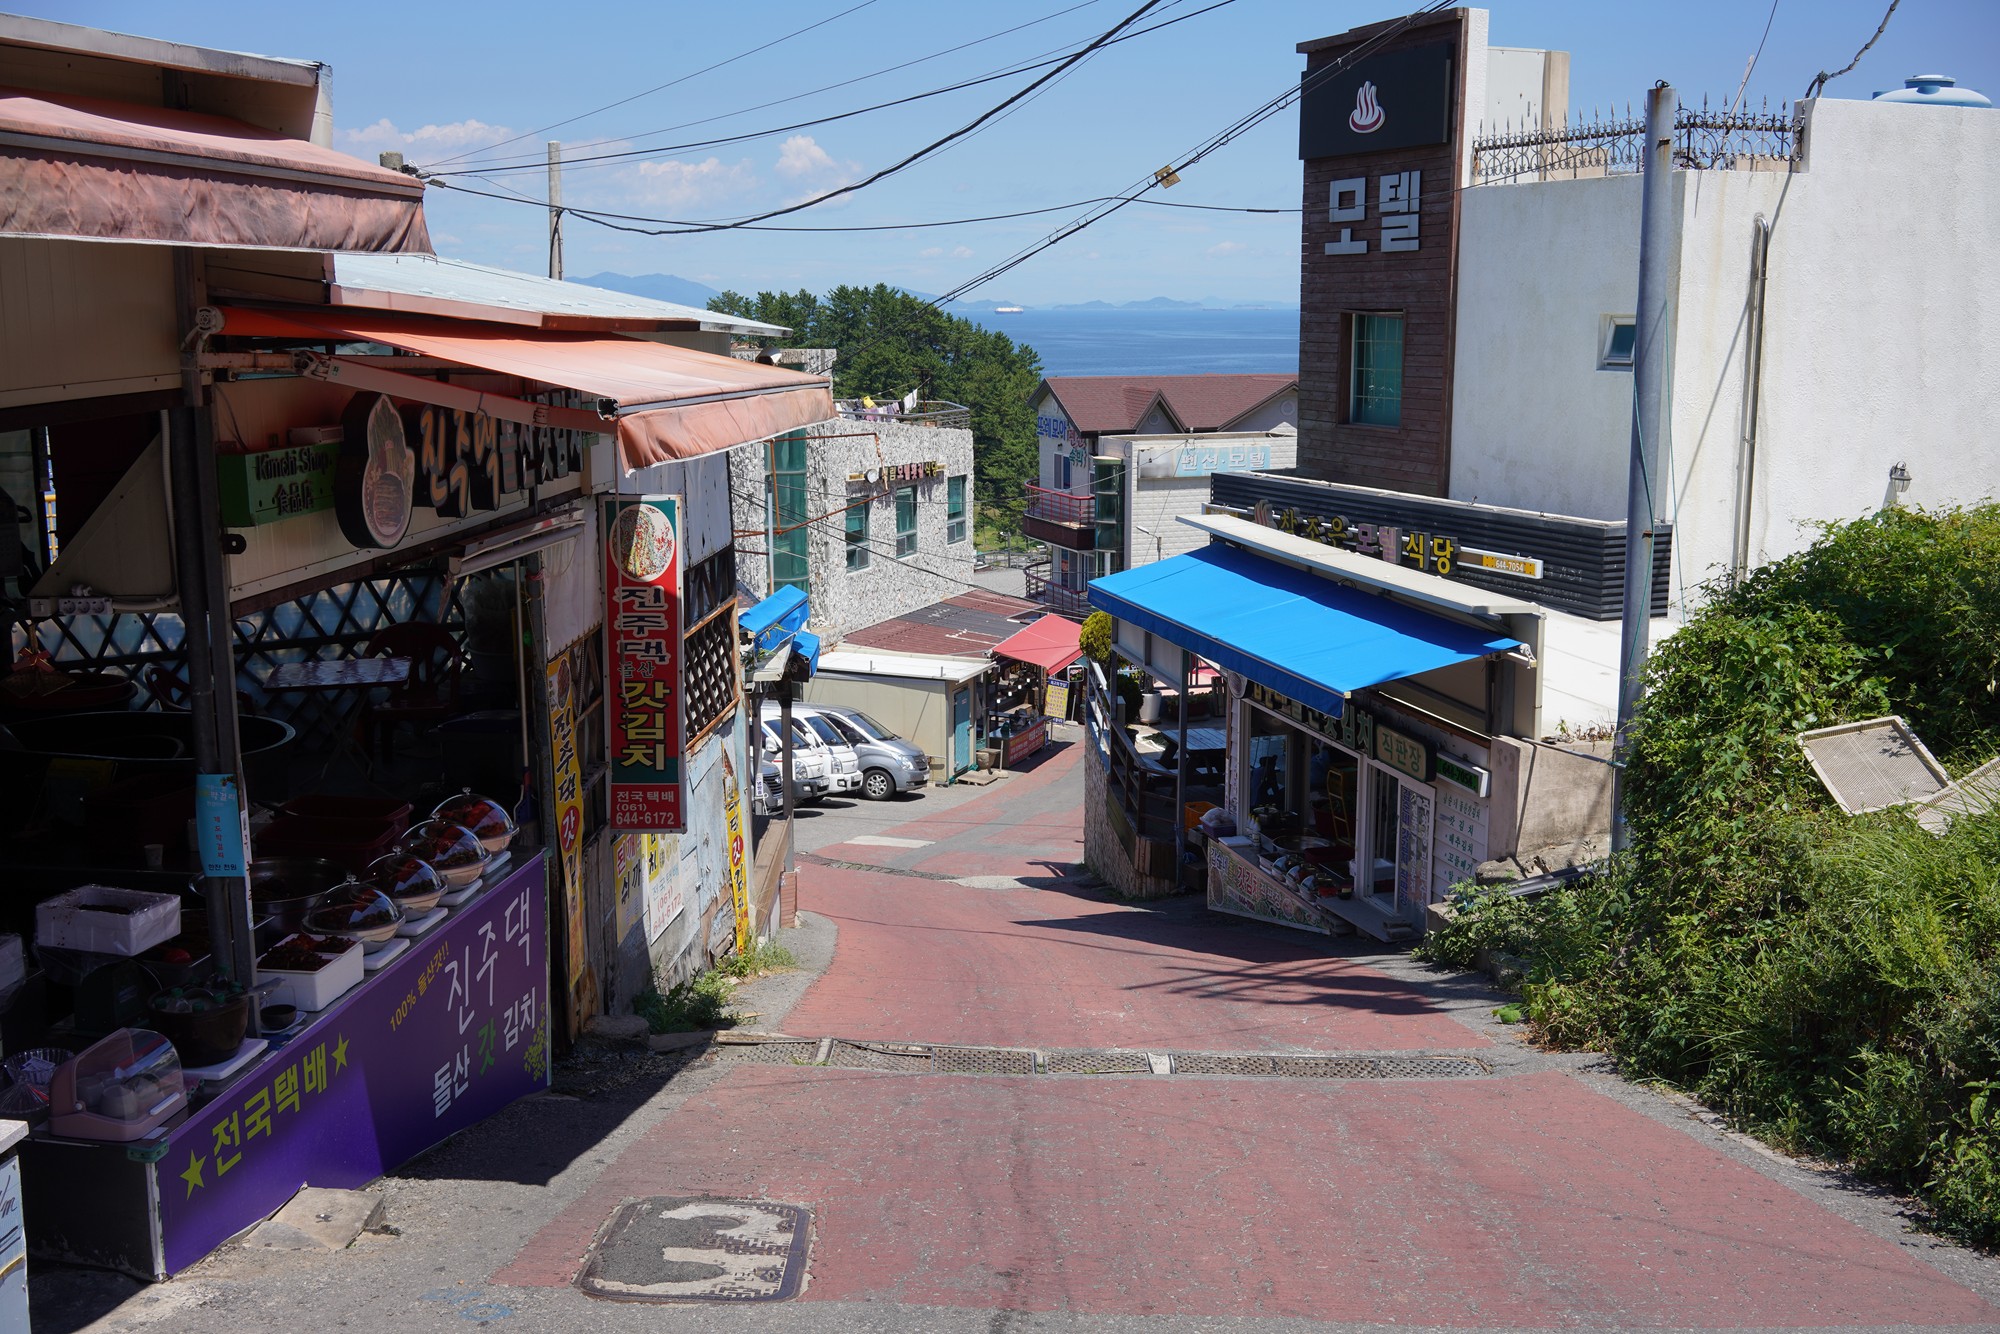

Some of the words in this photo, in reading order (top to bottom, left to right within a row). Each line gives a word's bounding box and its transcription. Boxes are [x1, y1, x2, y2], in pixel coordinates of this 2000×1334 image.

[1325, 170, 1421, 255] 모텔
[1405, 532, 1455, 574] 식당
[1494, 558, 1525, 574] 644-7054
[617, 587, 668, 663] 진주댁
[619, 681, 671, 772] 갓김치
[1381, 732, 1420, 773] 직판장
[616, 790, 676, 803] 전국택배
[616, 804, 647, 812] (061)
[616, 812, 675, 826] 644-6172
[443, 886, 532, 1036] 진주댁
[389, 989, 417, 1032] 100%
[432, 1043, 482, 1119] 돌산
[478, 1017, 507, 1077] 갓
[503, 986, 537, 1052] 김치
[212, 1041, 328, 1177] 전국택배
